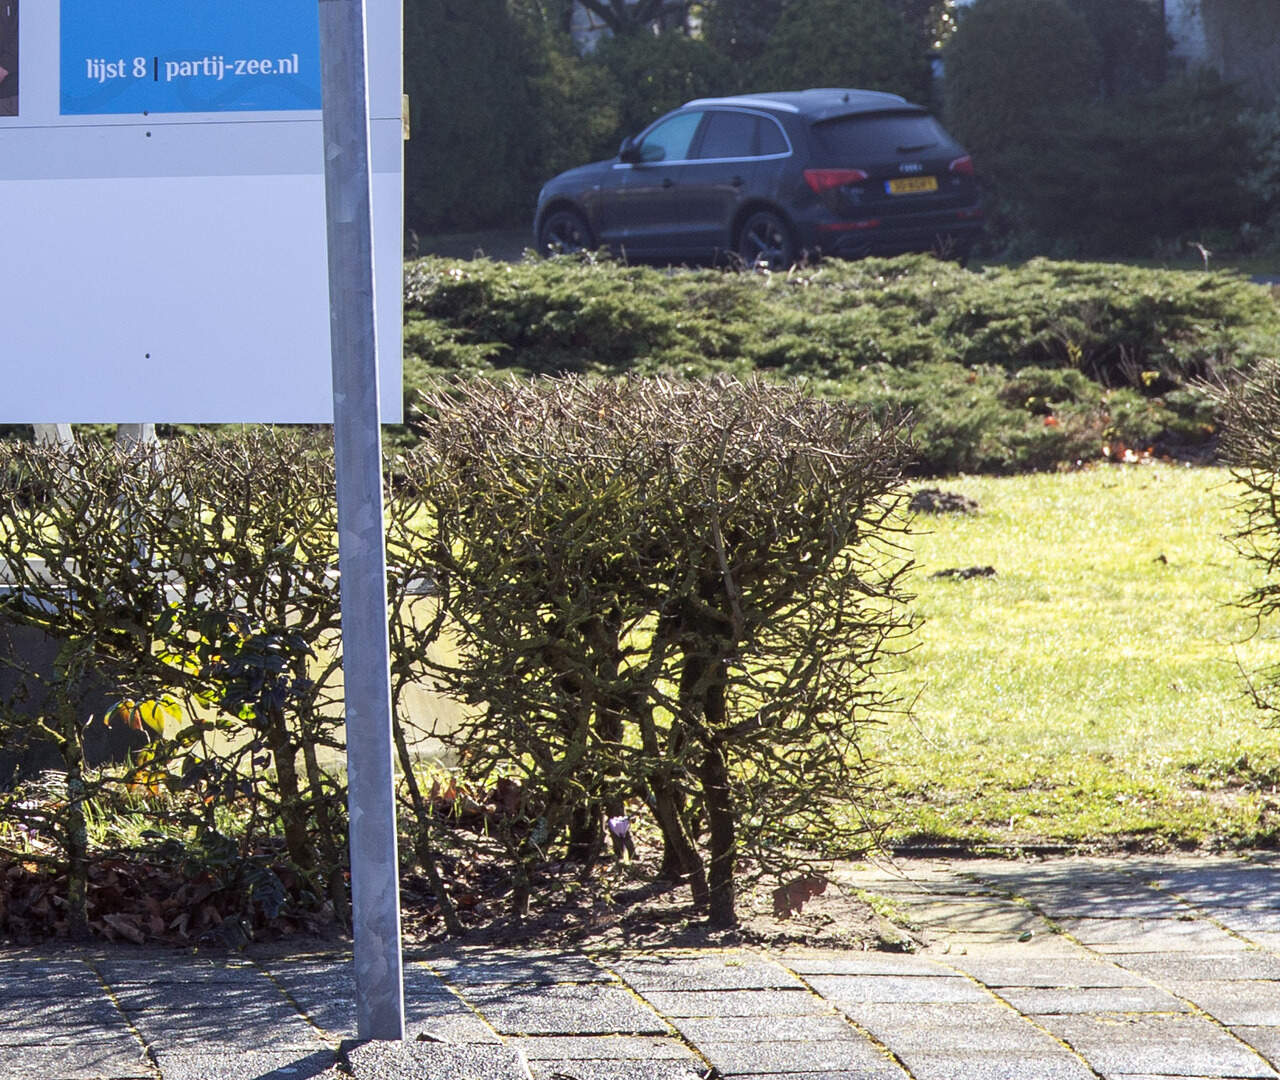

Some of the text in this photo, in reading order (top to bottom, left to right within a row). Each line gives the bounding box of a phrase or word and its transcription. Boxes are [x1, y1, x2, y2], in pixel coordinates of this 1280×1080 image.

[86, 57, 126, 83] lijst
[132, 57, 147, 78] 8
[165, 53, 298, 81] partij-zee.nl
